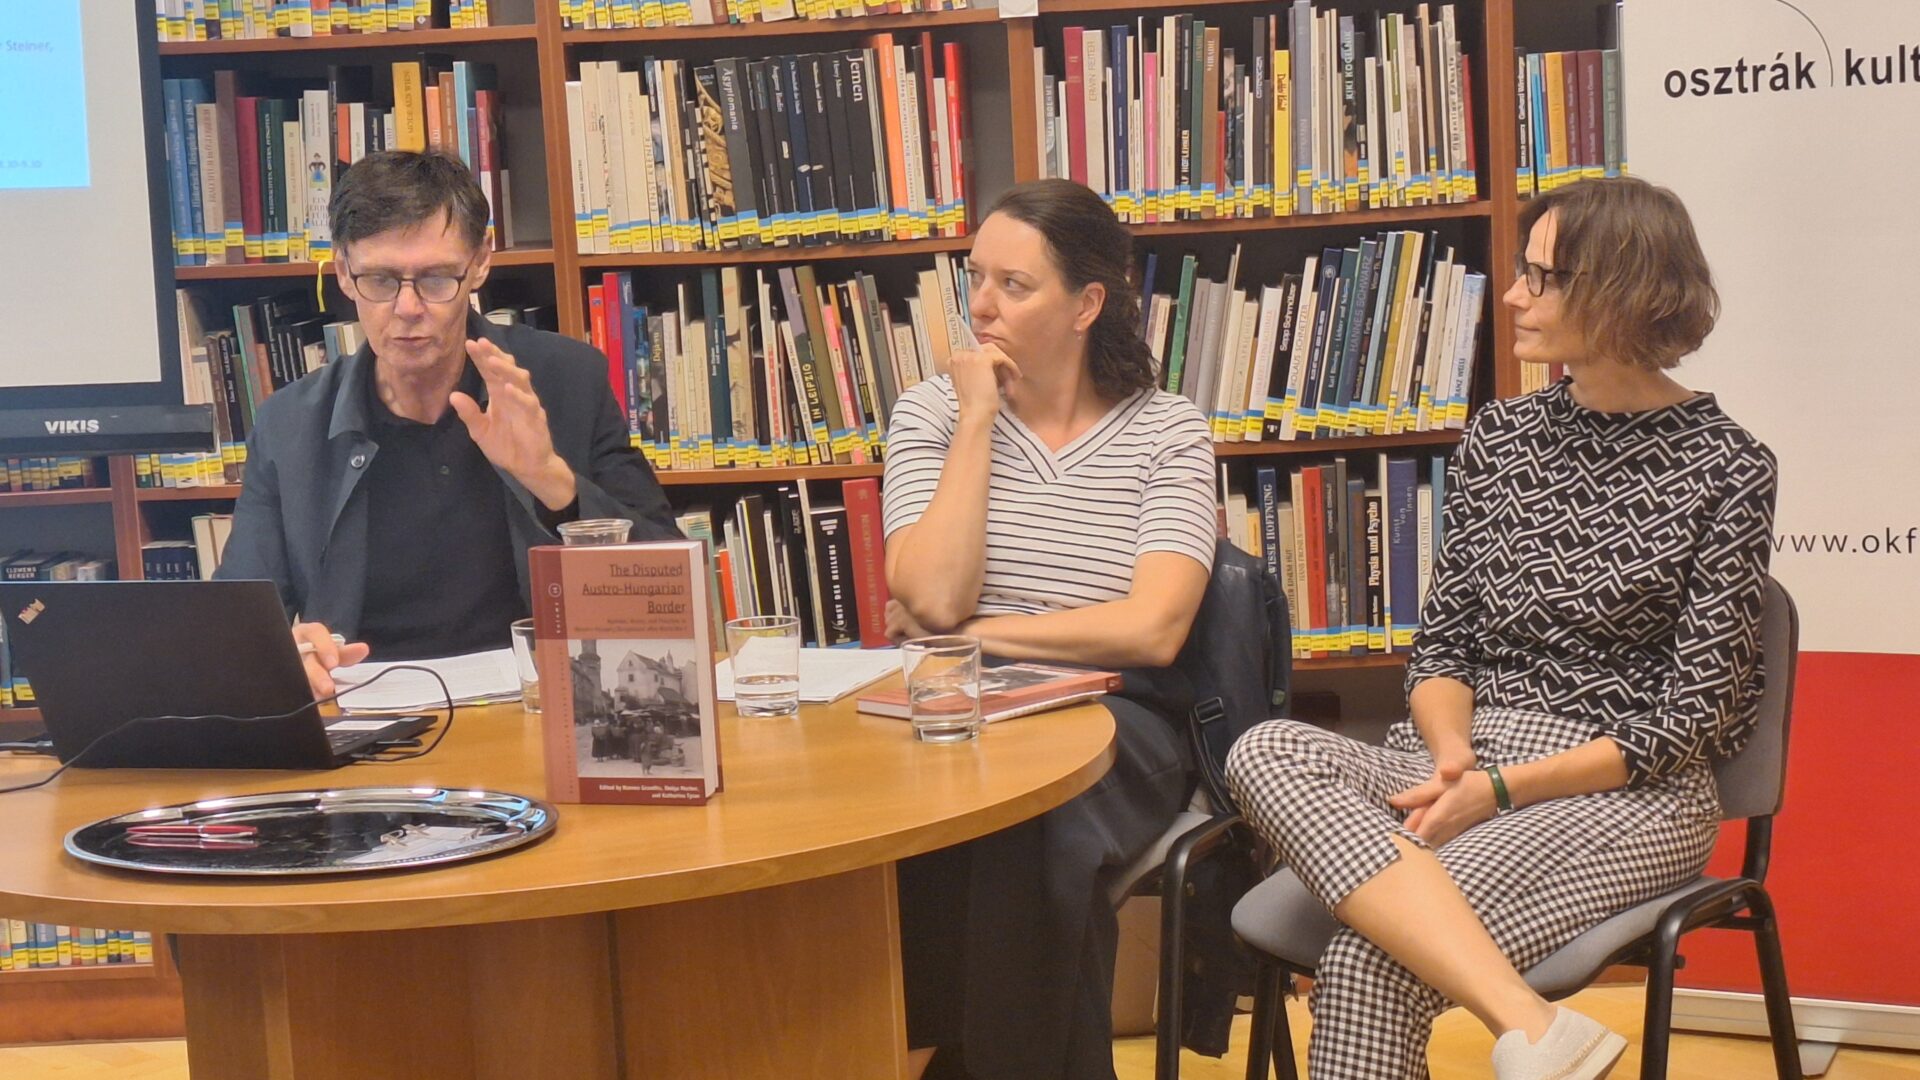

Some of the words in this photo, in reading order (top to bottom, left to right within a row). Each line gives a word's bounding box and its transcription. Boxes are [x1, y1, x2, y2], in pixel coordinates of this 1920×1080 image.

[6, 39, 54, 52] Steiner,
[1086, 40, 1095, 70] REITER
[1344, 30, 1355, 77] KOGELNIK
[402, 70, 411, 90] WIEN
[846, 53, 864, 102] Jemen
[1088, 73, 1097, 101] ERWIN
[1664, 51, 1816, 98] osztrák
[1346, 79, 1354, 99] KIKI
[1518, 94, 1526, 120] Gerhard
[647, 180, 658, 212] ERNST
[942, 286, 954, 315] Within
[1284, 282, 1297, 329] Schmölzer
[1349, 308, 1362, 352] HANNES
[1357, 254, 1371, 307] SCHWARZ
[950, 317, 960, 345] Search
[1280, 328, 1290, 351] Sepp
[651, 331, 662, 362] Déjà-vu
[803, 362, 818, 405] LEIPZIG
[45, 419, 100, 434] VIKIS
[811, 407, 822, 419] IN
[1264, 483, 1275, 539] HOFFNUNG
[1367, 535, 1379, 553] und
[1392, 517, 1401, 544] Kunst
[1421, 515, 1429, 549] AUSTRIA
[609, 563, 629, 577] The
[633, 563, 683, 580] Disputed
[1266, 543, 1277, 579] WISSE
[1368, 555, 1380, 585] Physis
[1421, 552, 1429, 575] INSEL
[582, 583, 684, 598] Austro-Hungarian
[832, 583, 841, 600] DES
[647, 602, 686, 614] Border
